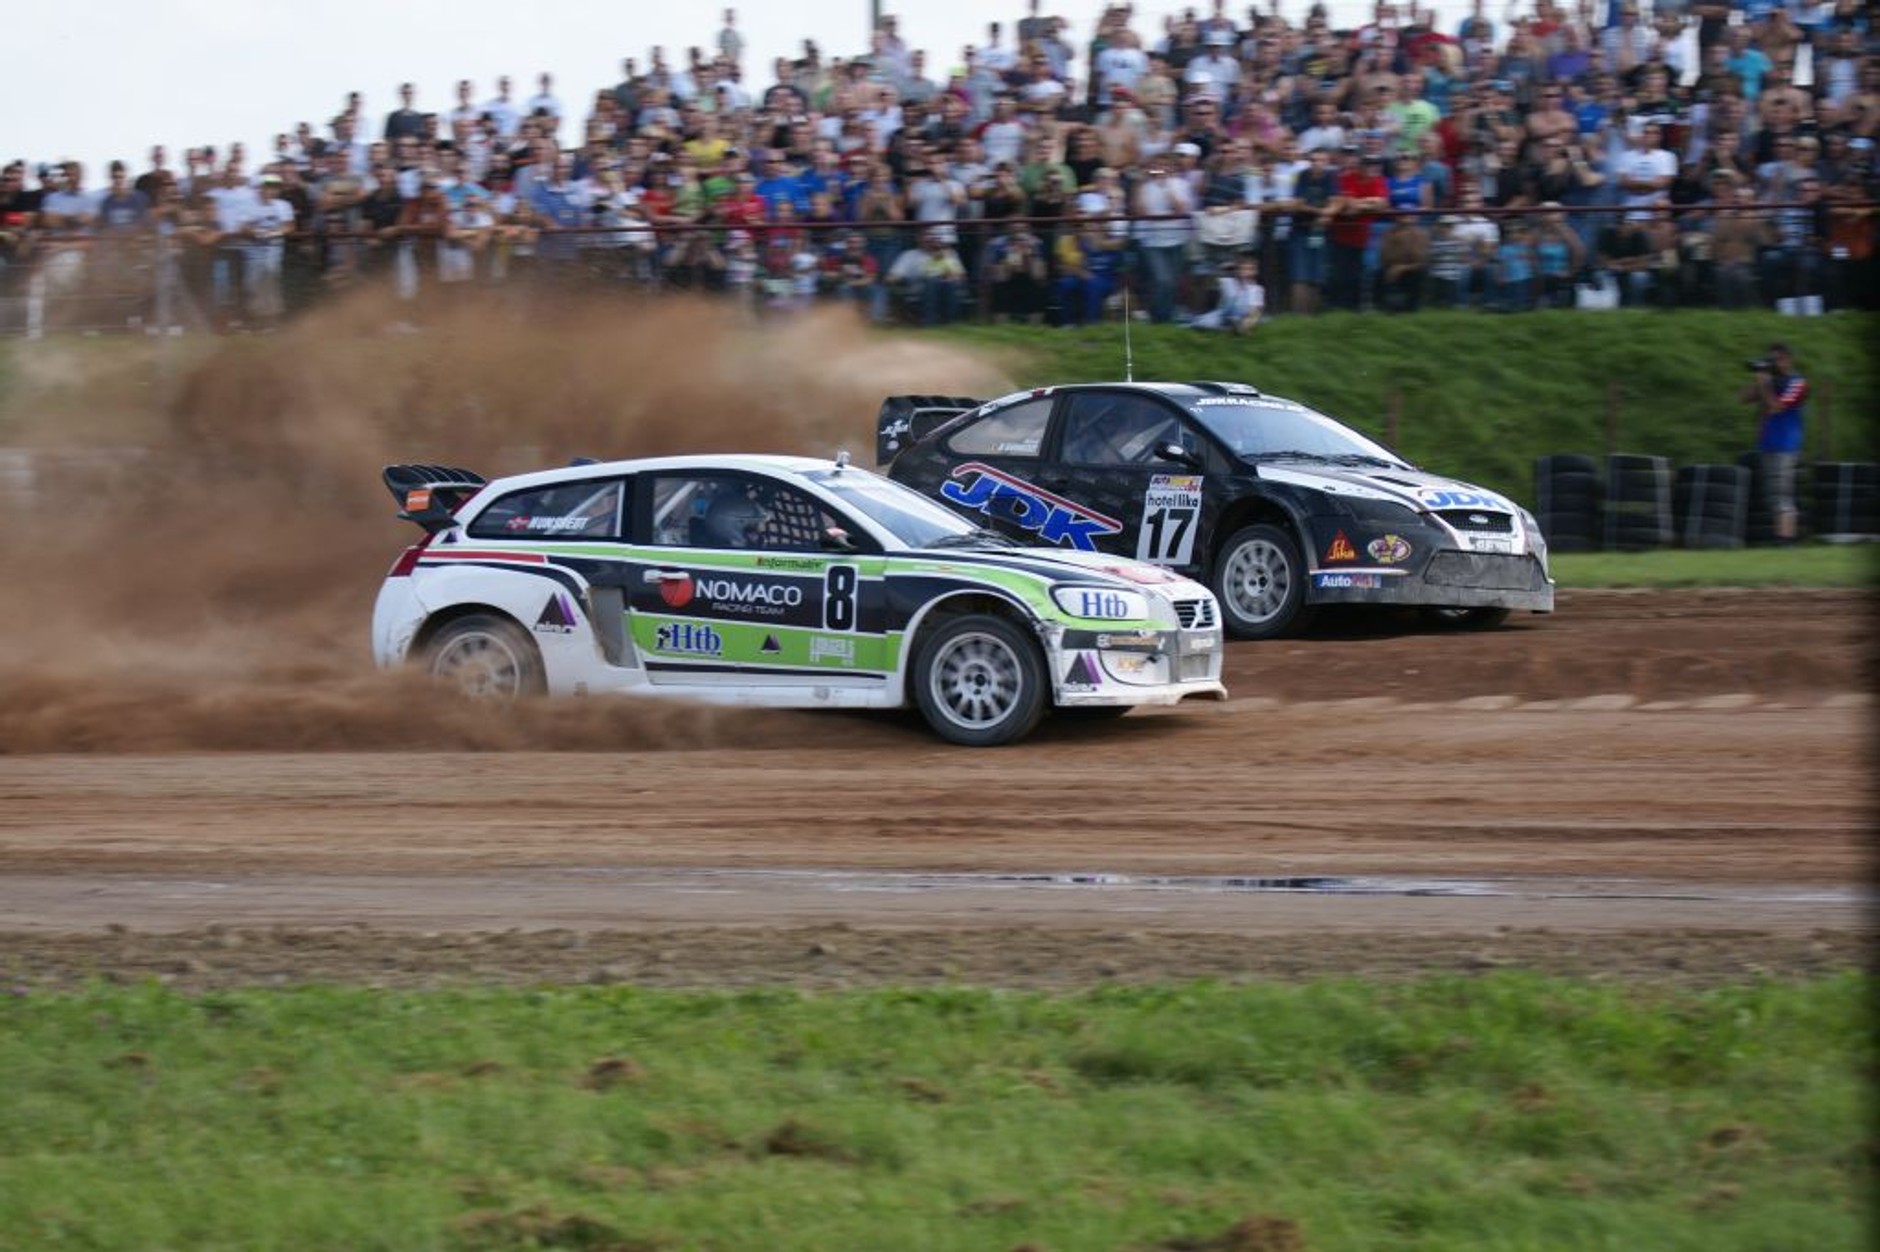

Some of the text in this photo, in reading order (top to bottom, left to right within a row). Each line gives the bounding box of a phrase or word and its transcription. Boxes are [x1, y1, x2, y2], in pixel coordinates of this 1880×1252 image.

[941, 463, 1122, 551] JDK
[1147, 492, 1176, 508] hotel
[1146, 508, 1195, 559] 17
[695, 580, 802, 606] NOMACO
[826, 565, 856, 631] 8
[1081, 592, 1128, 618] Htb
[712, 602, 785, 616] RACING TEAM
[669, 623, 722, 651] Htb
